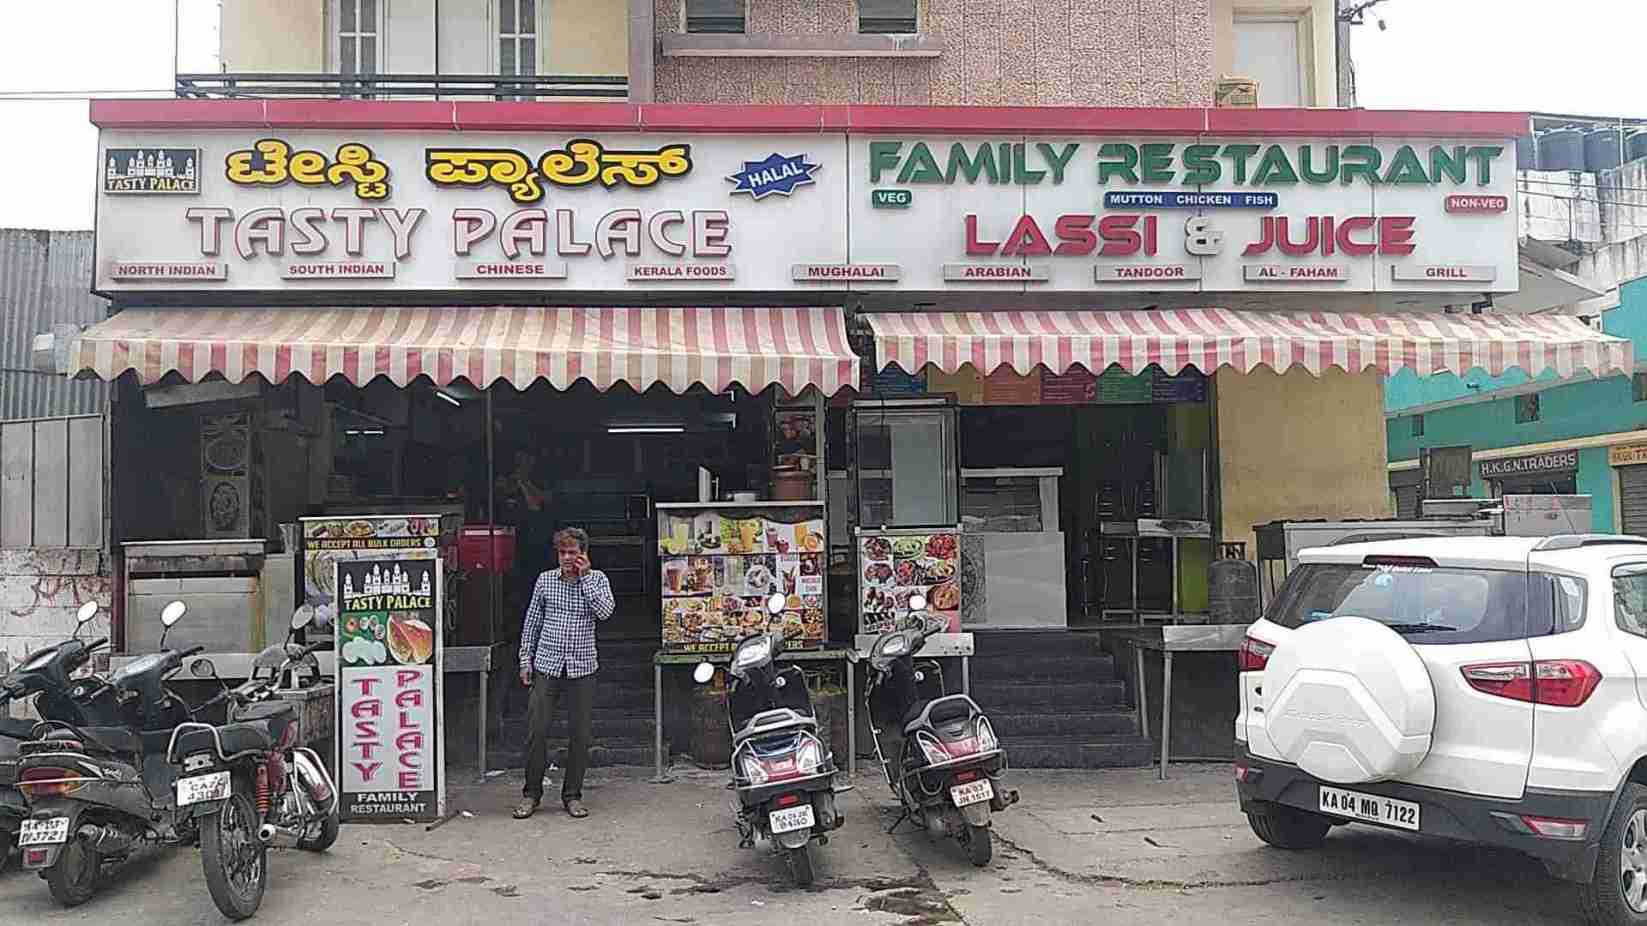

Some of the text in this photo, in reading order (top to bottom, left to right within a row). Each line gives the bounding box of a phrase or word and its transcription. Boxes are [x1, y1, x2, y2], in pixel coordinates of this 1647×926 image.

[225, 138, 391, 200] ಟೇಸ್ಟಿ
[869, 141, 1504, 187] FAMILY RESTAURANT
[747, 162, 804, 189] HALAL
[107, 177, 197, 191] TASTY PALACE
[877, 192, 907, 203] VEG
[1110, 195, 1274, 206] MUTTON CHICKEN FISH
[186, 207, 732, 261] TASTY PALACE
[964, 214, 1417, 257] LASSI & JUICE
[118, 264, 216, 276] NORTH INDIAN
[289, 264, 385, 275] SOUTH INDIAN
[476, 263, 545, 275] CHINESE
[634, 265, 727, 277] KERALA FOODS
[808, 266, 885, 278] MUGHALAI
[965, 266, 1032, 278] ARABIAN
[1115, 266, 1185, 278] TANDOOR
[1289, 267, 1338, 278] FAHAM
[1425, 267, 1468, 278] GRILL
[344, 595, 432, 610] TASTY PALACE
[351, 678, 383, 782] TASTY
[395, 670, 424, 788] PALACE
[357, 793, 418, 802] FAMILY
[350, 803, 426, 814] RESTAURANT
[1322, 791, 1338, 808] KA
[1341, 794, 1355, 812] 04
[1385, 802, 1415, 824] 7122
